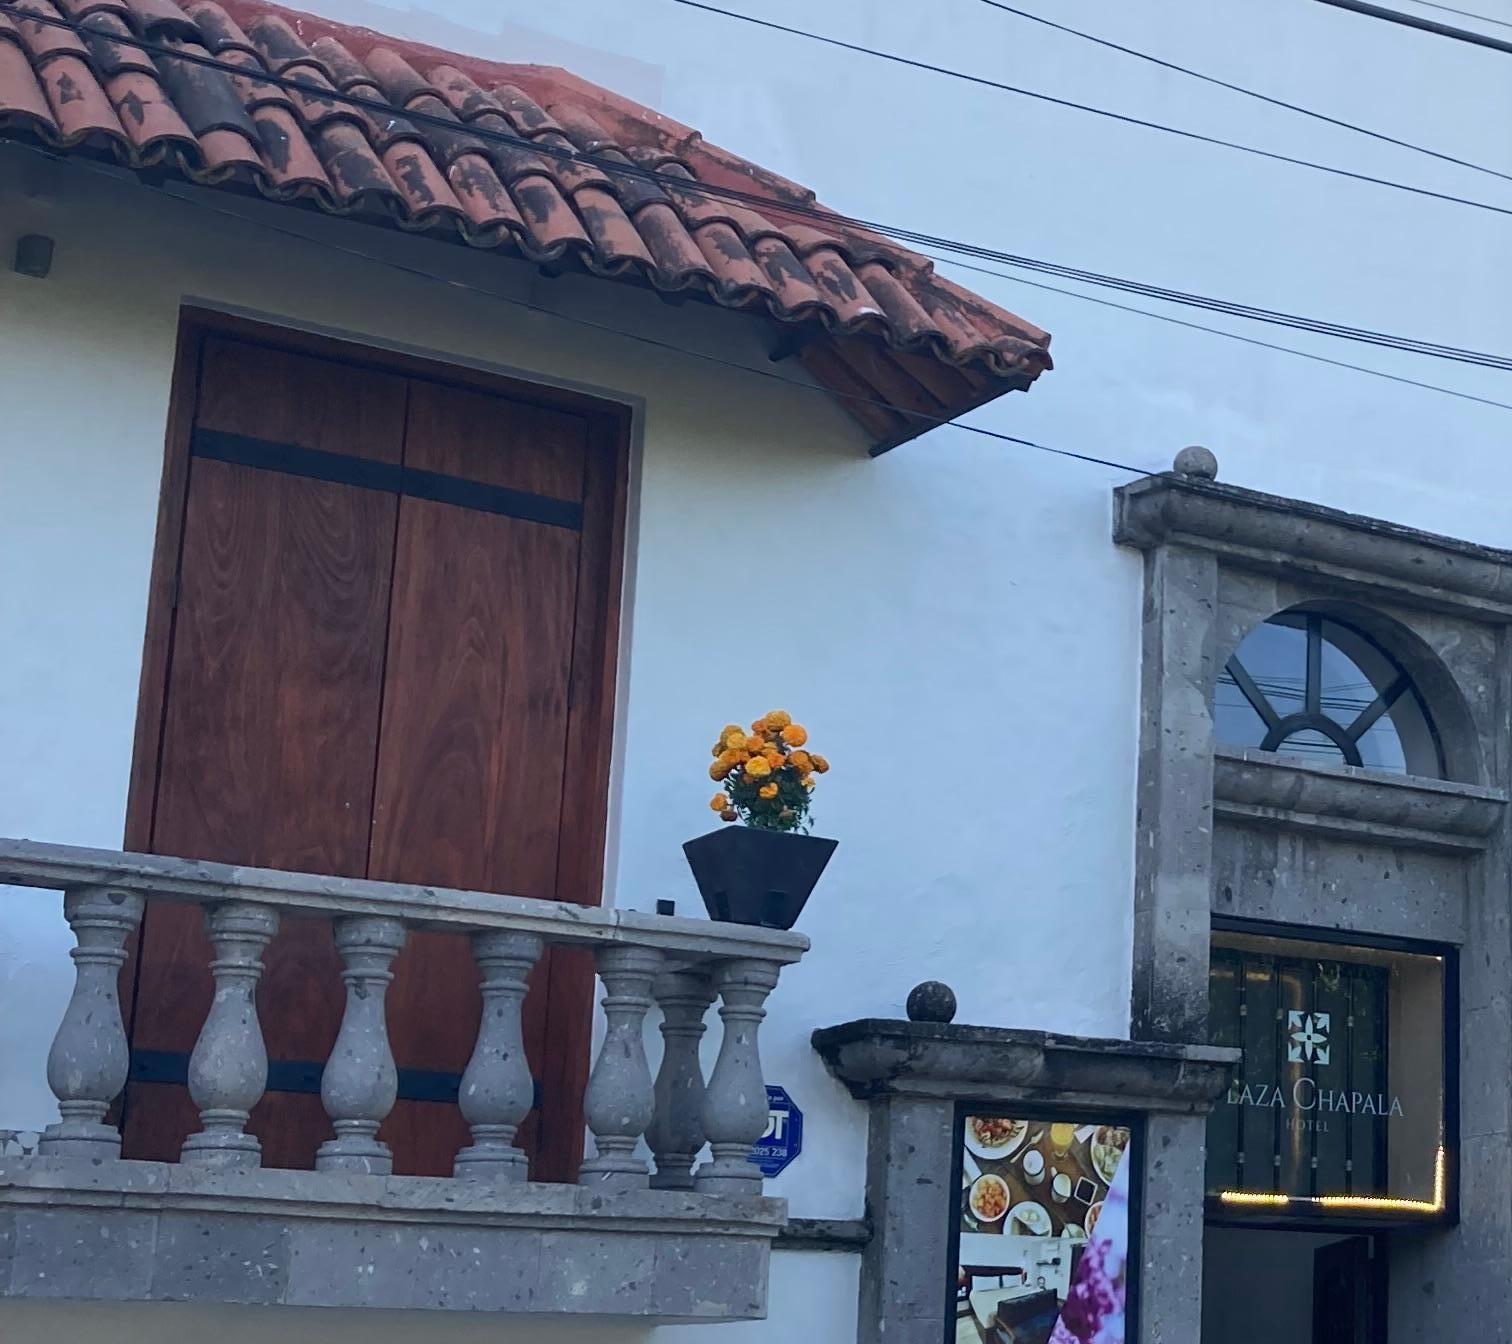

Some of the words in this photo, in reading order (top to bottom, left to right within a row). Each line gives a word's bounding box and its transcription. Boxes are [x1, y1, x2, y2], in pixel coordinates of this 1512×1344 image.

[1228, 1083, 1286, 1108] LAZA
[1293, 1077, 1404, 1117] CHAPALA
[1286, 1118, 1329, 1133] HOTEL
